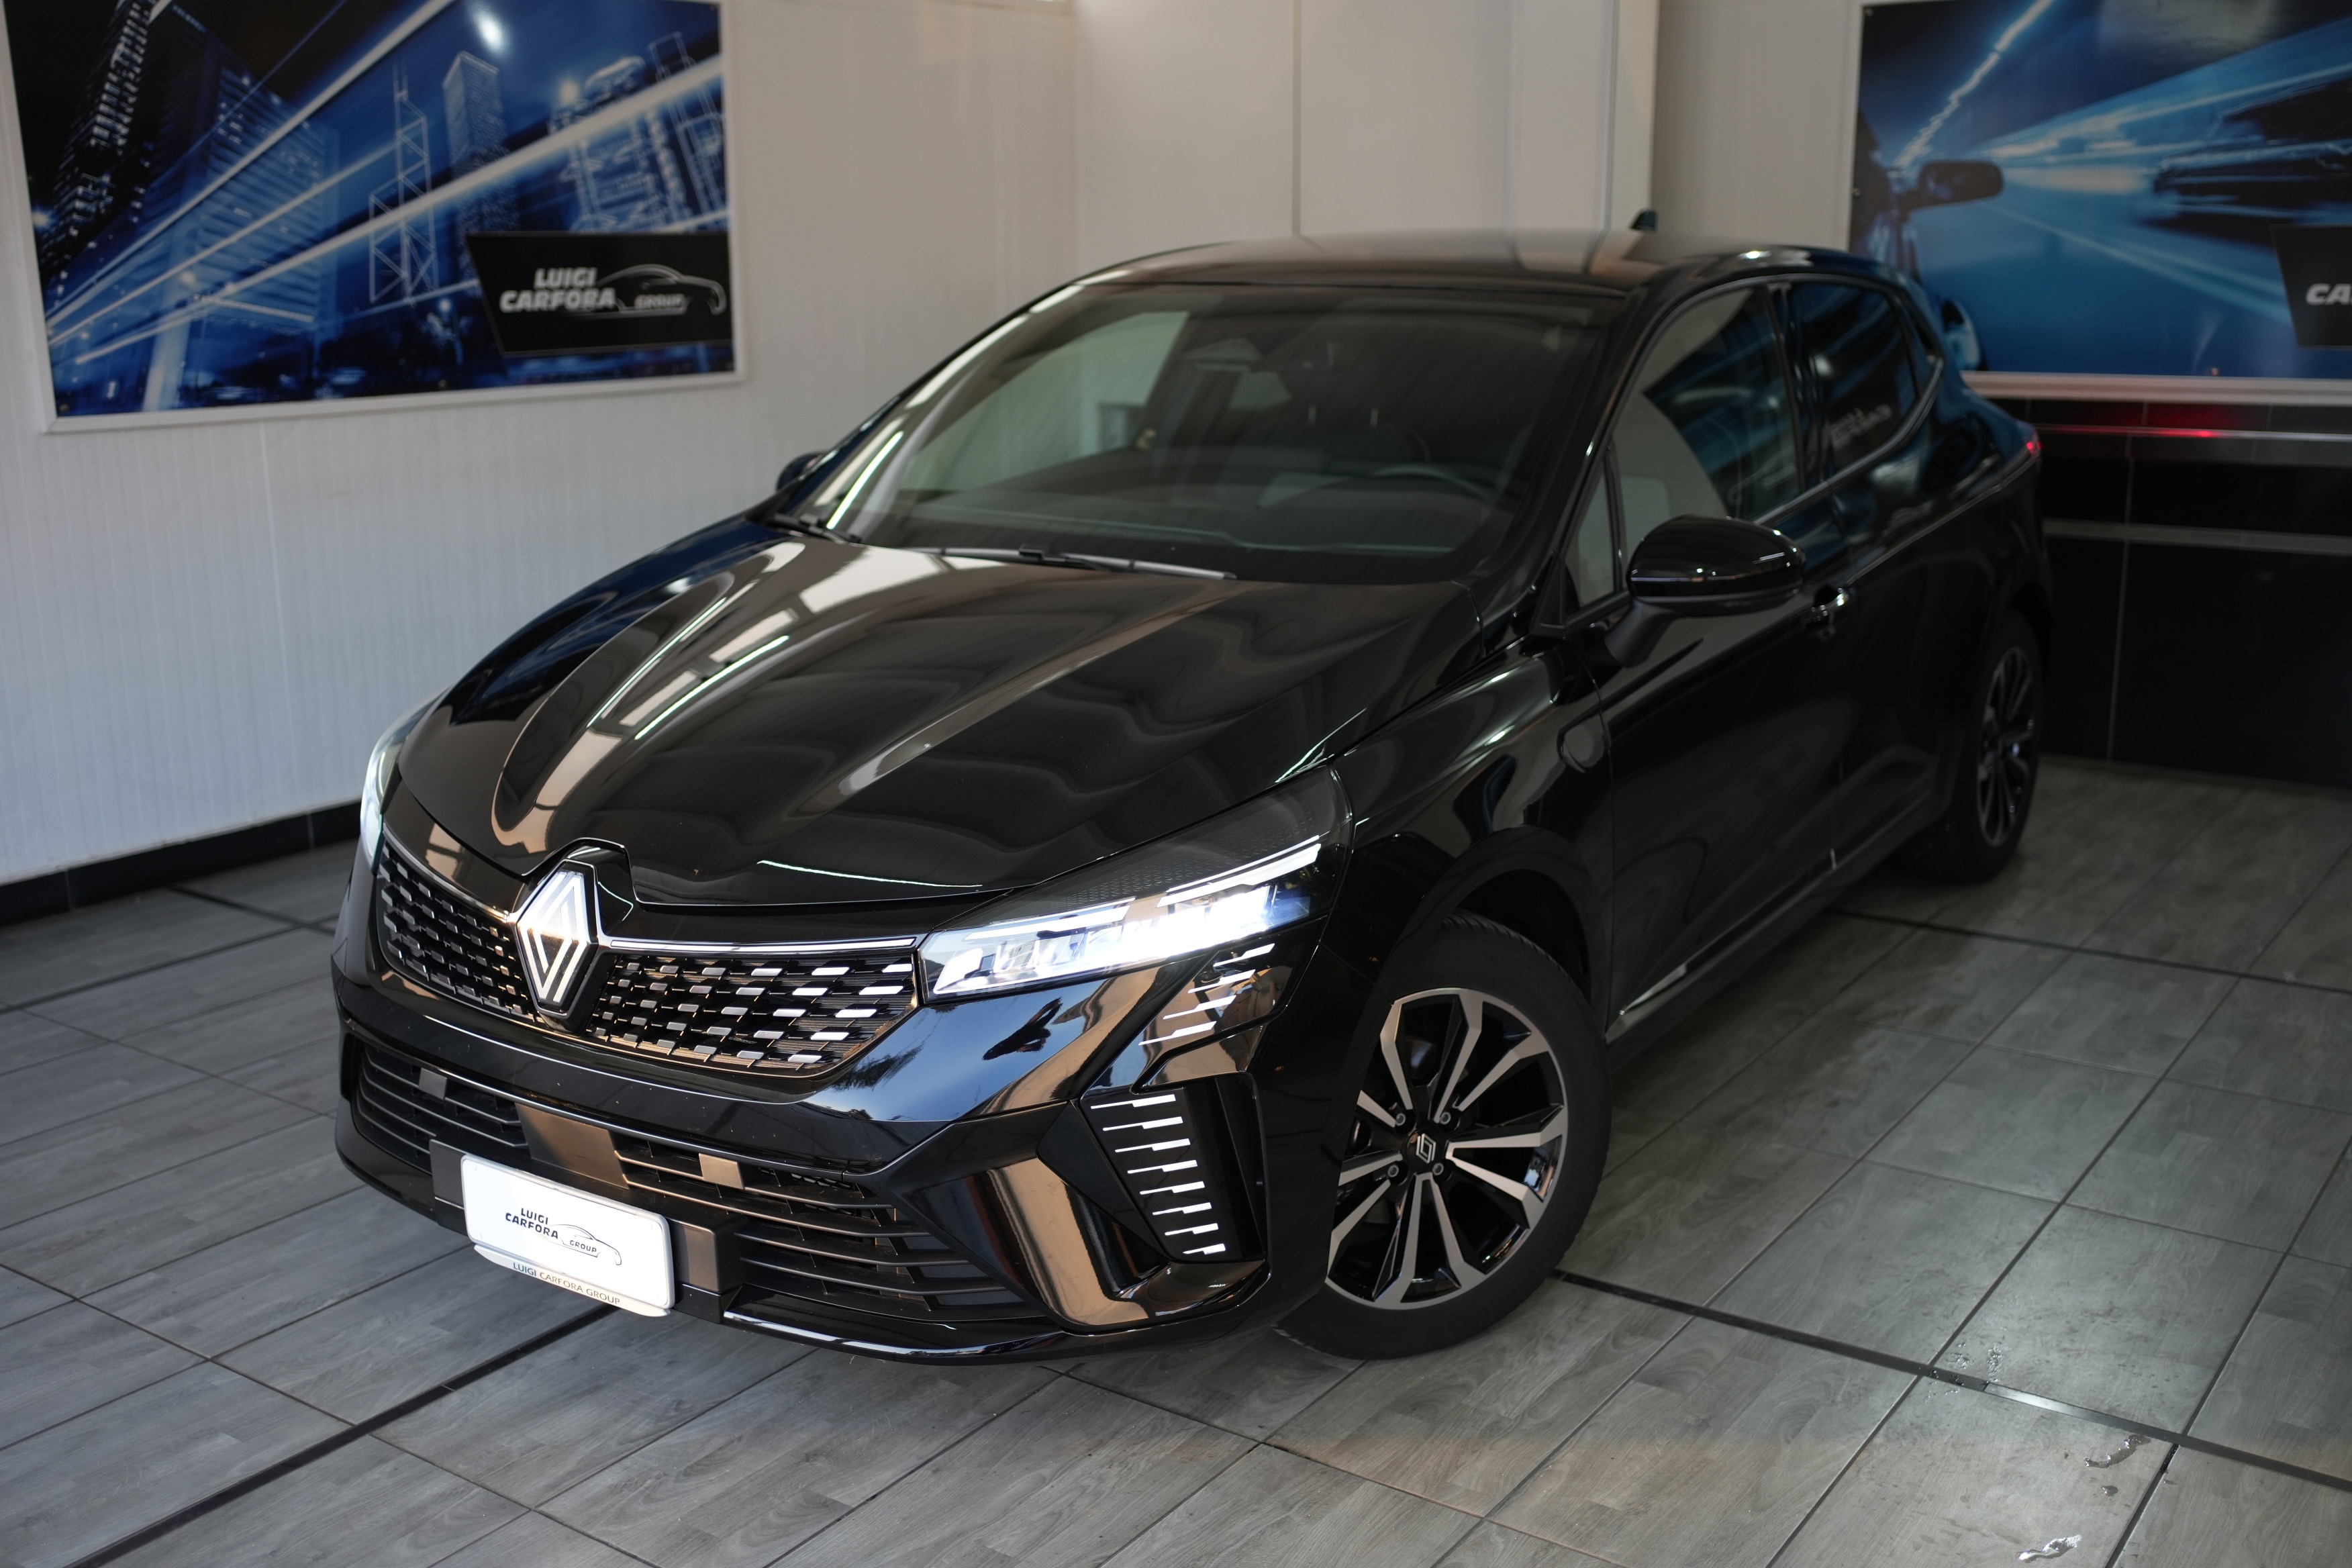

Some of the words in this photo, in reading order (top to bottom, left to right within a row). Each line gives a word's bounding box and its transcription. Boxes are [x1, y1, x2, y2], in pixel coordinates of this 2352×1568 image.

[534, 266, 598, 289] LUIGI
[499, 287, 616, 313] CARFORA
[634, 293, 685, 309] GROUP
[2305, 283, 2352, 305] CA
[520, 1208, 549, 1225] LUIGI
[505, 1212, 559, 1240] CARFORA
[569, 1240, 597, 1253] GROUP
[512, 1262, 538, 1277] LUIGI
[539, 1271, 584, 1292] CARFORA
[586, 1288, 621, 1305] GROUP
